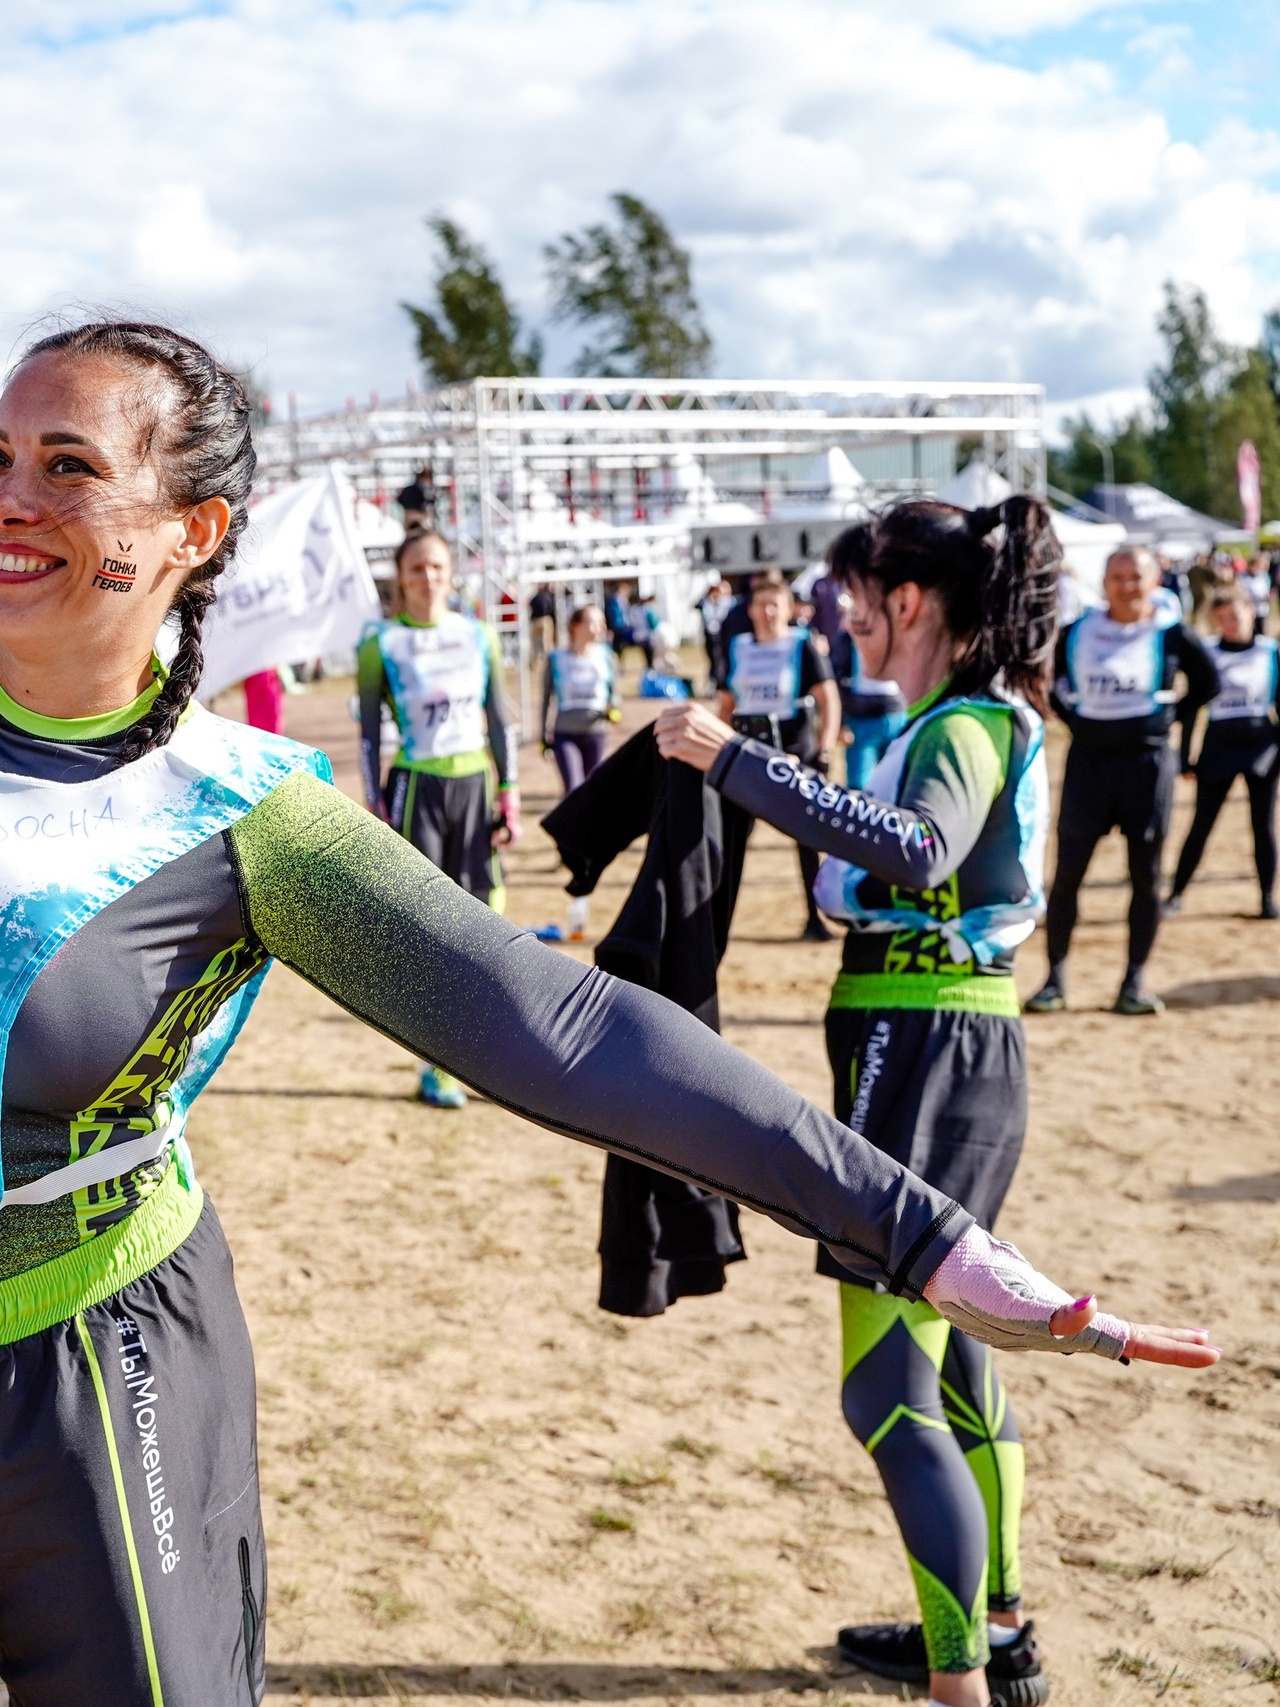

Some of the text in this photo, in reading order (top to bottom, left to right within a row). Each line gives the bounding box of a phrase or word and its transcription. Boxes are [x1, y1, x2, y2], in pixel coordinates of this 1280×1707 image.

[91, 574, 134, 593] ГЕРОЕВ
[102, 557, 137, 576] ГОНКА
[766, 756, 915, 847] Greenway
[805, 804, 881, 845] GLOBAL
[849, 1020, 891, 1134] #ТыМожеш
[117, 1315, 181, 1575] #ТыМожешьВсё
